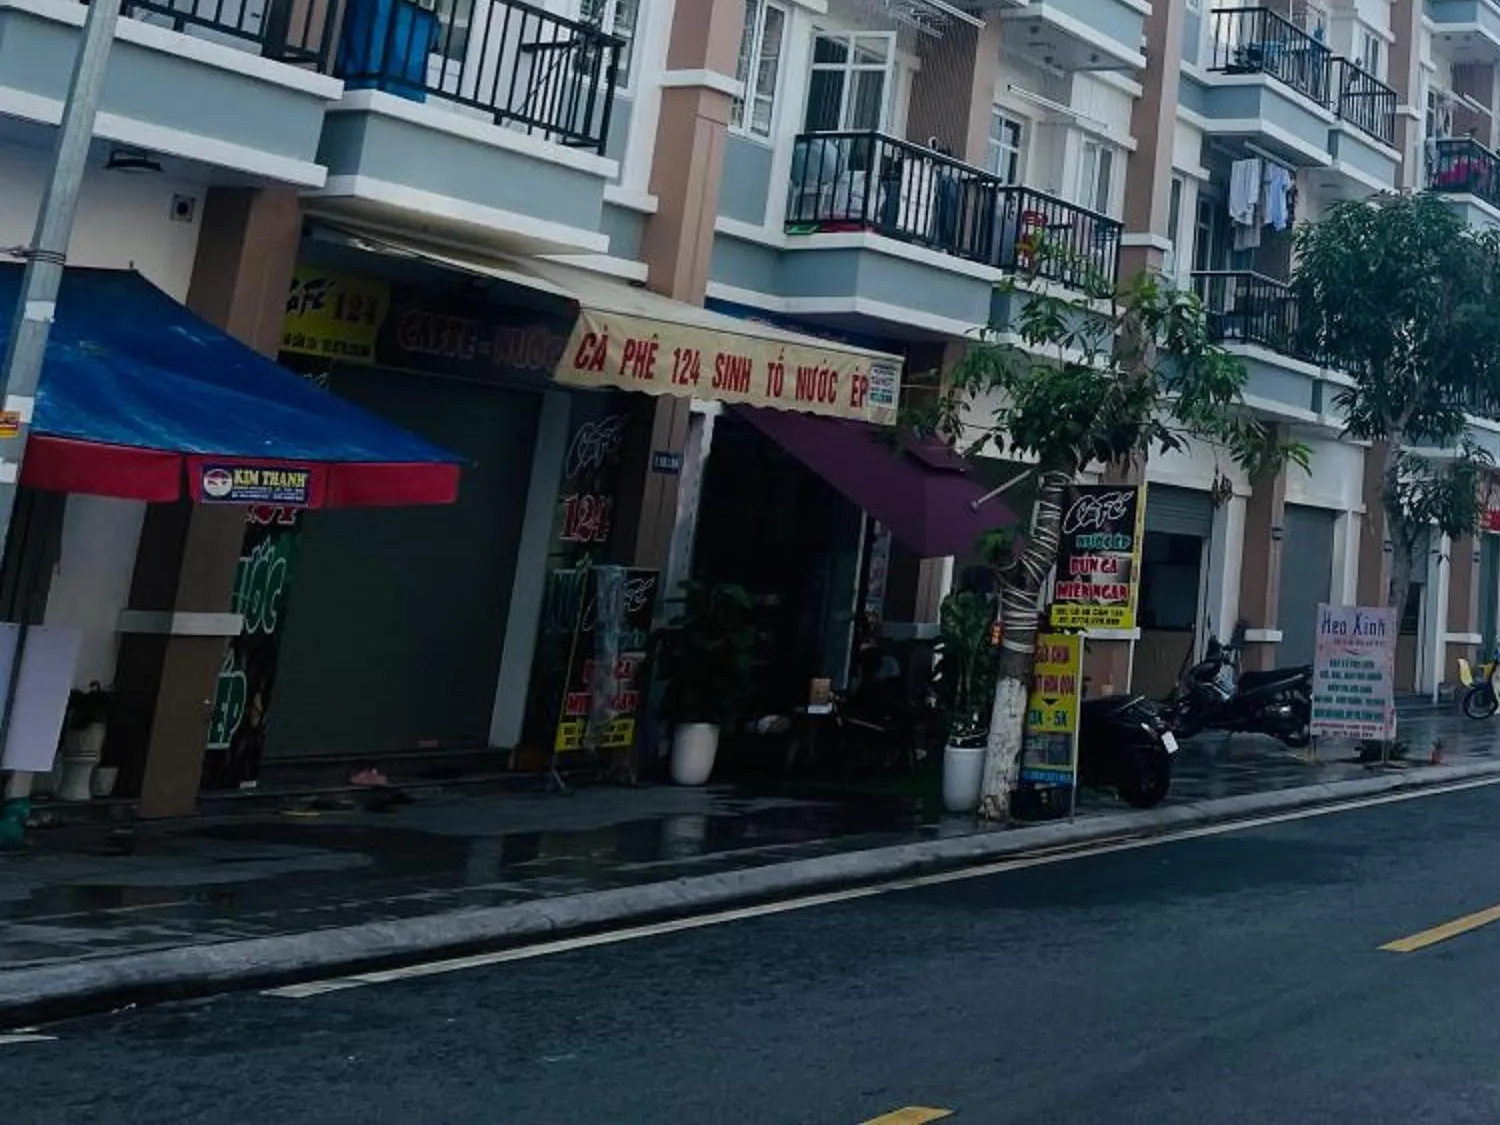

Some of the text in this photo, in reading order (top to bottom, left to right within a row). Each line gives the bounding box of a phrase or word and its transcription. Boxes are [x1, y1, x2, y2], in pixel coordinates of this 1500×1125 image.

[619, 333, 659, 380] PHÊ
[670, 346, 700, 387] 124
[711, 352, 752, 393] SINH
[796, 357, 839, 404] NƯỚC
[850, 365, 869, 407] ÉP
[234, 469, 307, 488] KIM THANH
[560, 490, 611, 543] 124
